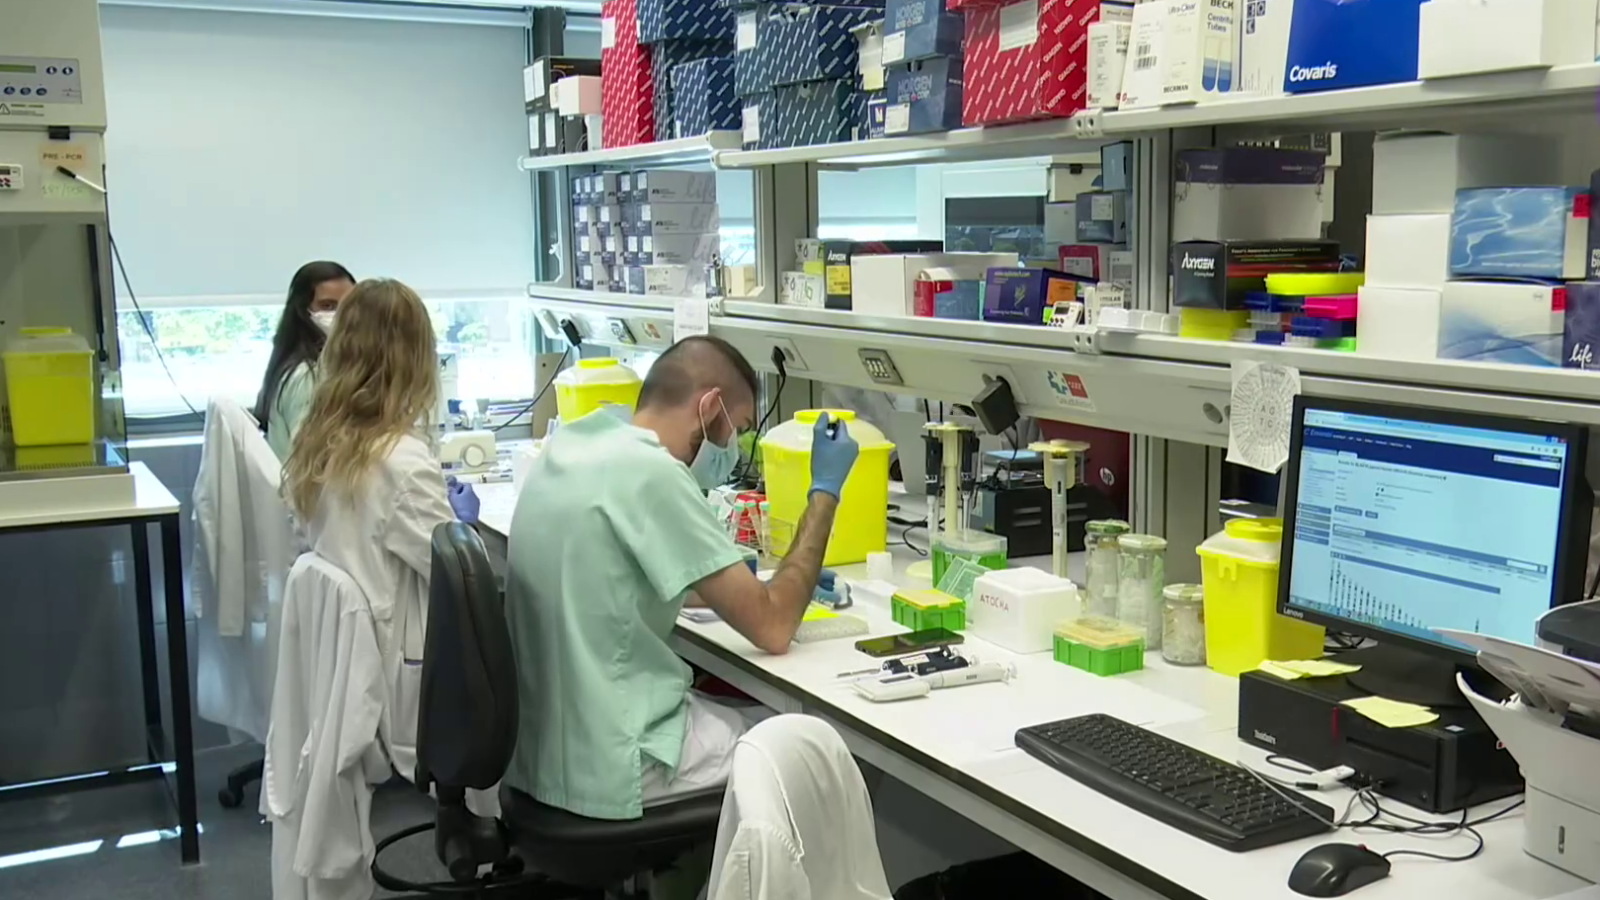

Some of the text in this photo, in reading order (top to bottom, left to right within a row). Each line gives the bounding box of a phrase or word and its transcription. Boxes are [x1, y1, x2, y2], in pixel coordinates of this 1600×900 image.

[1207, 22, 1227, 33] Tubes
[1043, 41, 1063, 62] QIAGEN
[1058, 61, 1077, 81] QIAGEN
[1289, 61, 1338, 83] Covaris
[1163, 85, 1189, 94] BECKMAN
[43, 152, 58, 160] PRE
[65, 153, 82, 161] PCR
[1181, 251, 1215, 270] AXYGEN
[1569, 343, 1593, 369] life
[1283, 606, 1304, 618] Lenovo
